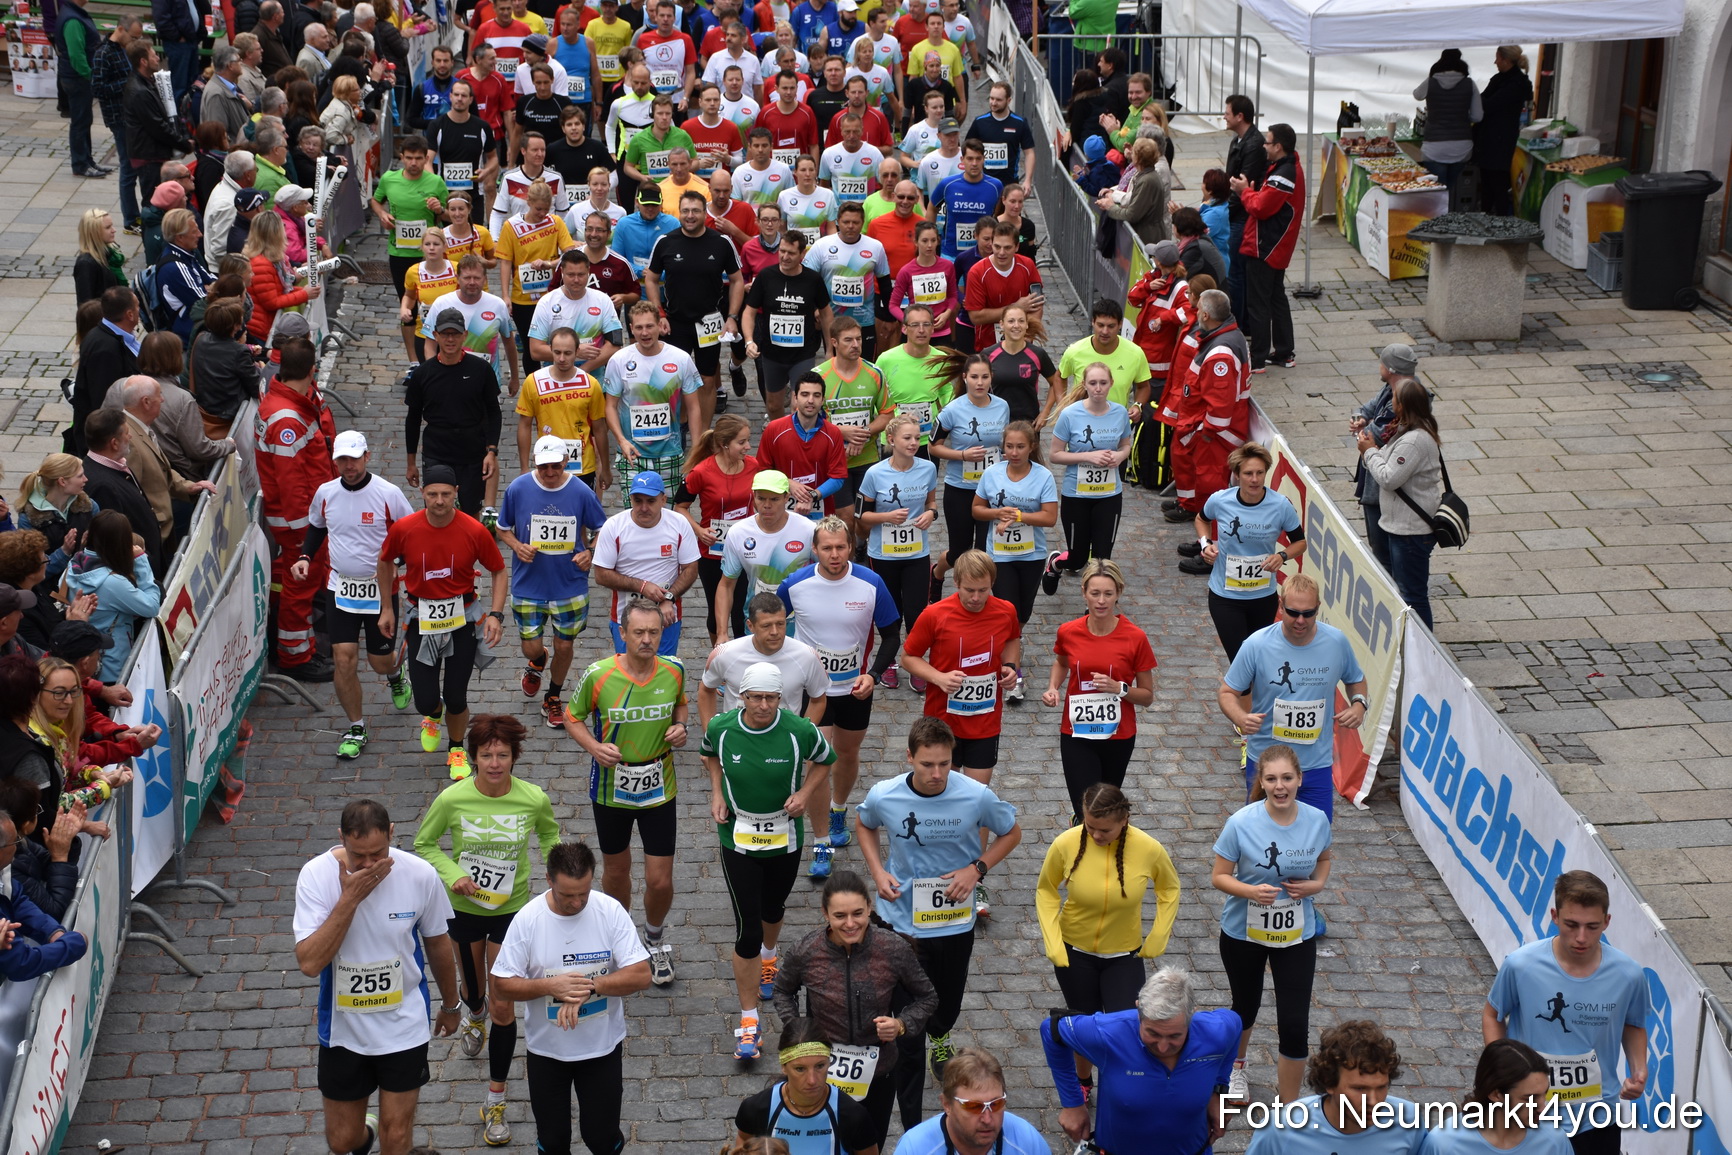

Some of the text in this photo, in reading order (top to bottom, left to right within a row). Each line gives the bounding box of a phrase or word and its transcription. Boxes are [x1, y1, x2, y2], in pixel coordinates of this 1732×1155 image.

[498, 63, 518, 73] 2095
[600, 60, 615, 70] 186
[655, 76, 676, 86] 2467
[424, 94, 439, 105] 22
[983, 145, 1006, 161] 2510
[649, 157, 668, 168] 248
[446, 169, 471, 181] 2222
[840, 182, 866, 194] 2729
[953, 201, 986, 210] SYSCAD
[401, 226, 422, 239] 502
[519, 227, 559, 247] MAX BÖGL
[309, 232, 317, 252] BMW
[448, 248, 464, 256] MAX
[522, 269, 552, 283] 2735
[438, 279, 456, 289] BÖGL
[834, 282, 863, 296] 2345
[920, 279, 942, 295] 182
[780, 301, 799, 310] Berlin
[703, 321, 723, 335] 324
[773, 321, 802, 336] 2179
[780, 336, 794, 344] Peter
[540, 391, 592, 406] MAX BÖGL
[826, 395, 874, 410] BOCK
[635, 412, 668, 428] 2442
[643, 428, 661, 437] Tobias
[1096, 428, 1111, 436] GYM
[1085, 469, 1110, 484] 337
[903, 487, 920, 495] GYM
[1089, 485, 1105, 493] Katrin
[539, 525, 568, 541] 314
[1244, 523, 1262, 531] GYM
[890, 528, 916, 544] 191
[1004, 529, 1023, 544] 75
[540, 542, 566, 551] Heinrich
[893, 544, 914, 553] Sandra
[1003, 544, 1025, 553] Hannah
[1235, 564, 1264, 579] 142
[1306, 500, 1393, 658] Egner
[339, 581, 377, 599] 3030
[428, 602, 457, 620] 237
[430, 619, 455, 630] Michael
[820, 654, 858, 673] 3024
[1297, 665, 1331, 676] GYM HIP
[953, 683, 993, 702] 2296
[961, 702, 984, 712] Reiner
[1071, 696, 1112, 706] PARTL Neumarkt
[1274, 702, 1293, 711] PARTL
[608, 702, 675, 724] BOCK
[1074, 703, 1118, 723] 2548
[1284, 711, 1317, 729] 183
[1088, 725, 1105, 734] Julia
[1283, 730, 1315, 740] Christian
[616, 766, 633, 776] PARTL
[620, 771, 661, 793] 2793
[625, 790, 654, 802] Helmuth
[517, 814, 529, 841] 2015
[752, 821, 775, 834] 12
[925, 818, 962, 828] GYM HIP
[751, 835, 772, 846] Steve
[1285, 847, 1317, 858] GYM HIP
[460, 856, 509, 872] PARTL Neumarkt
[468, 865, 507, 892] 357
[914, 882, 935, 890] PARTL
[931, 889, 957, 909] 64
[1270, 902, 1297, 912] Neumarkt
[920, 910, 966, 924] Christopher
[1260, 910, 1296, 931] 108
[1265, 933, 1288, 944] Tanja
[337, 963, 394, 974] PARTL Neumarkt
[349, 971, 393, 994] 255
[351, 995, 388, 1008] Gerhard
[1573, 1001, 1618, 1013] GYM HIP
[836, 1046, 869, 1058] Neumarkt
[1553, 1057, 1590, 1066] Neumarkt
[828, 1055, 865, 1081] 256
[1549, 1065, 1590, 1089] 150
